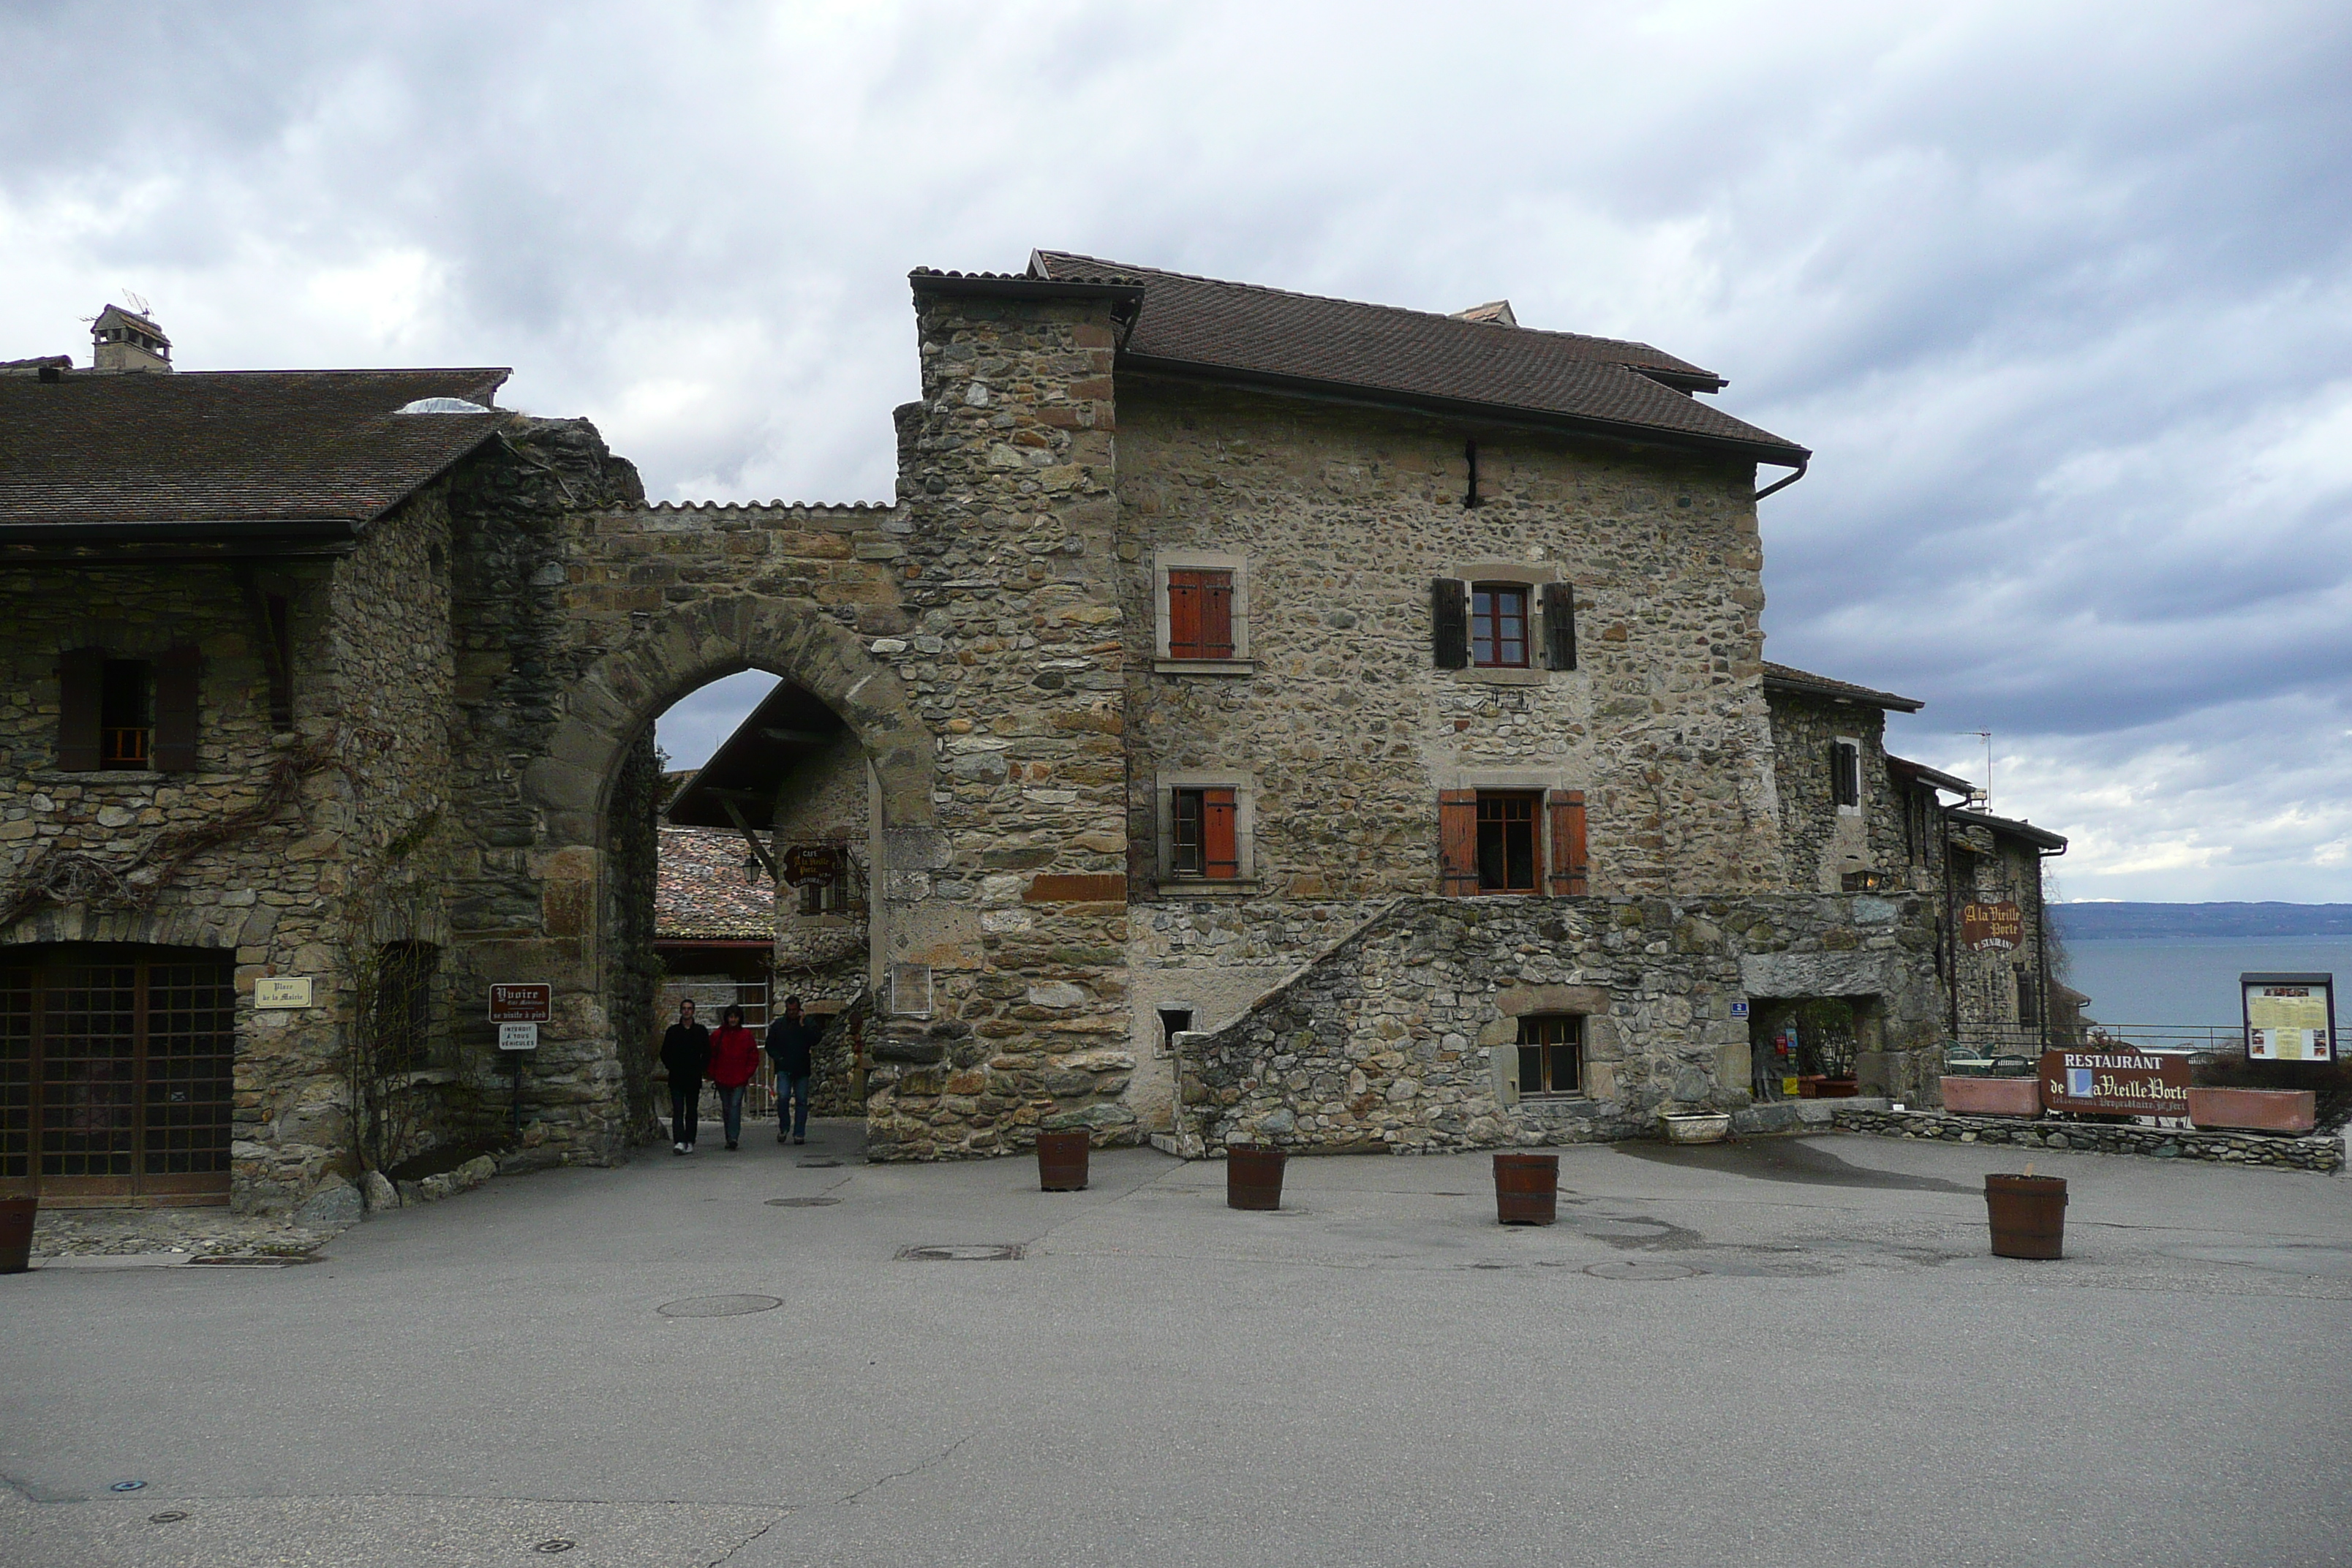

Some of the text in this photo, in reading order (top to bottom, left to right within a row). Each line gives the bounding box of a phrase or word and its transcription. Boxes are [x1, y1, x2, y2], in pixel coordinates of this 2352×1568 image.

[1978, 908, 1989, 921] la
[1989, 906, 2020, 921] Vieille
[1990, 922, 2018, 937] Porte
[274, 983, 293, 992] Place
[496, 987, 538, 1003] Yvoire
[279, 993, 304, 1001] Mairie
[503, 1011, 523, 1019] visite
[532, 1011, 546, 1020] pied
[2065, 1054, 2163, 1069] RESTAURANT
[2050, 1079, 2065, 1094] de
[2099, 1074, 2148, 1098] Vieille
[2146, 1076, 2188, 1100] Porte
